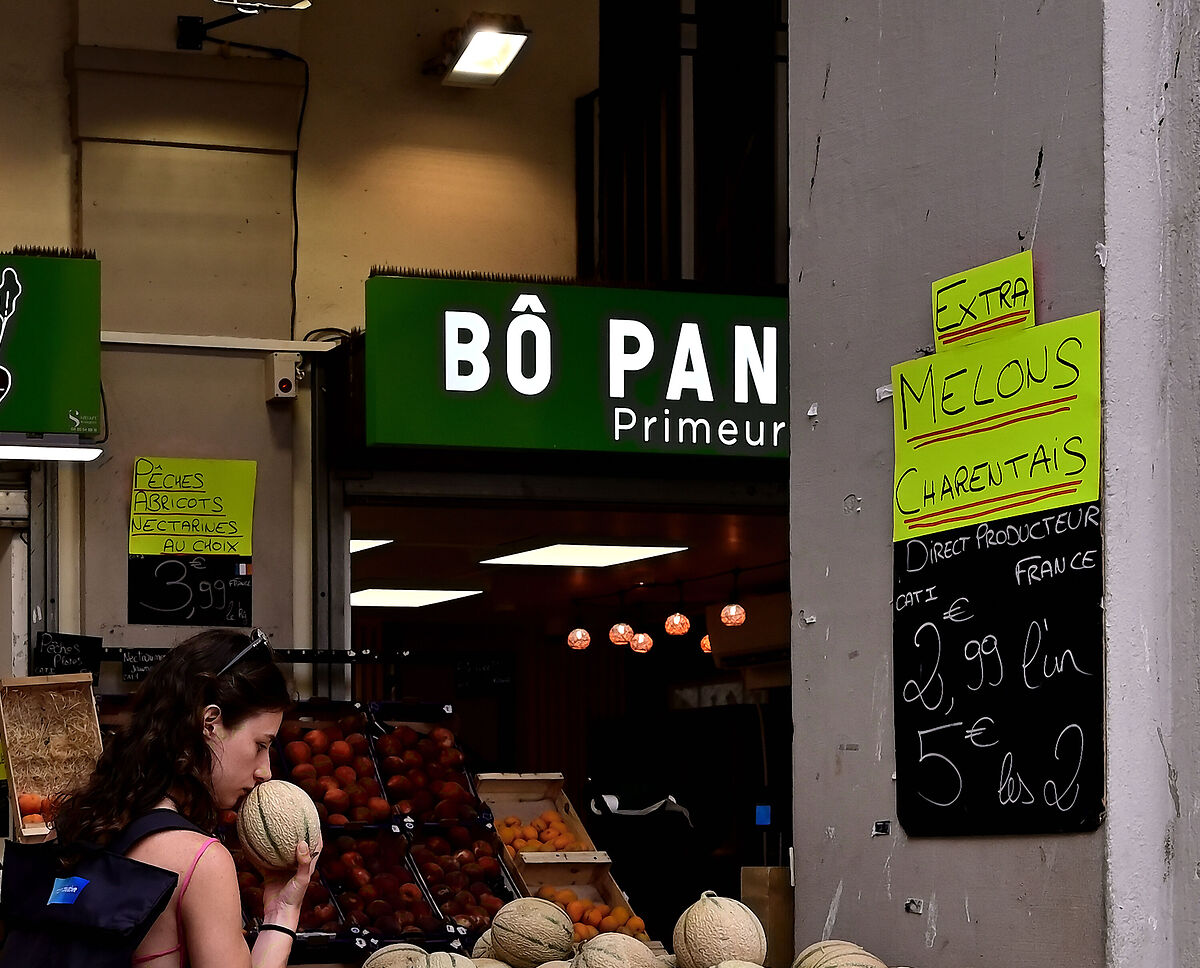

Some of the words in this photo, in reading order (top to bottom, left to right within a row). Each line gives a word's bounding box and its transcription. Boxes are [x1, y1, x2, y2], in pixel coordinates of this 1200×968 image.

[936, 279, 1029, 332] EXTRA
[443, 293, 553, 397] BÔ
[900, 337, 1082, 430] MELONS
[613, 407, 787, 448] Primeur
[134, 458, 204, 489] PÊCHES
[896, 436, 1086, 515] CHARENTAIS
[133, 491, 224, 513] ABRICOTS
[131, 518, 239, 535] NECTARINES
[163, 539, 186, 552] AU
[192, 540, 240, 552] CHOIX
[906, 537, 970, 572] DIRECT
[976, 505, 1100, 549] PRODUCTEUR
[1015, 550, 1097, 585] FRANCE
